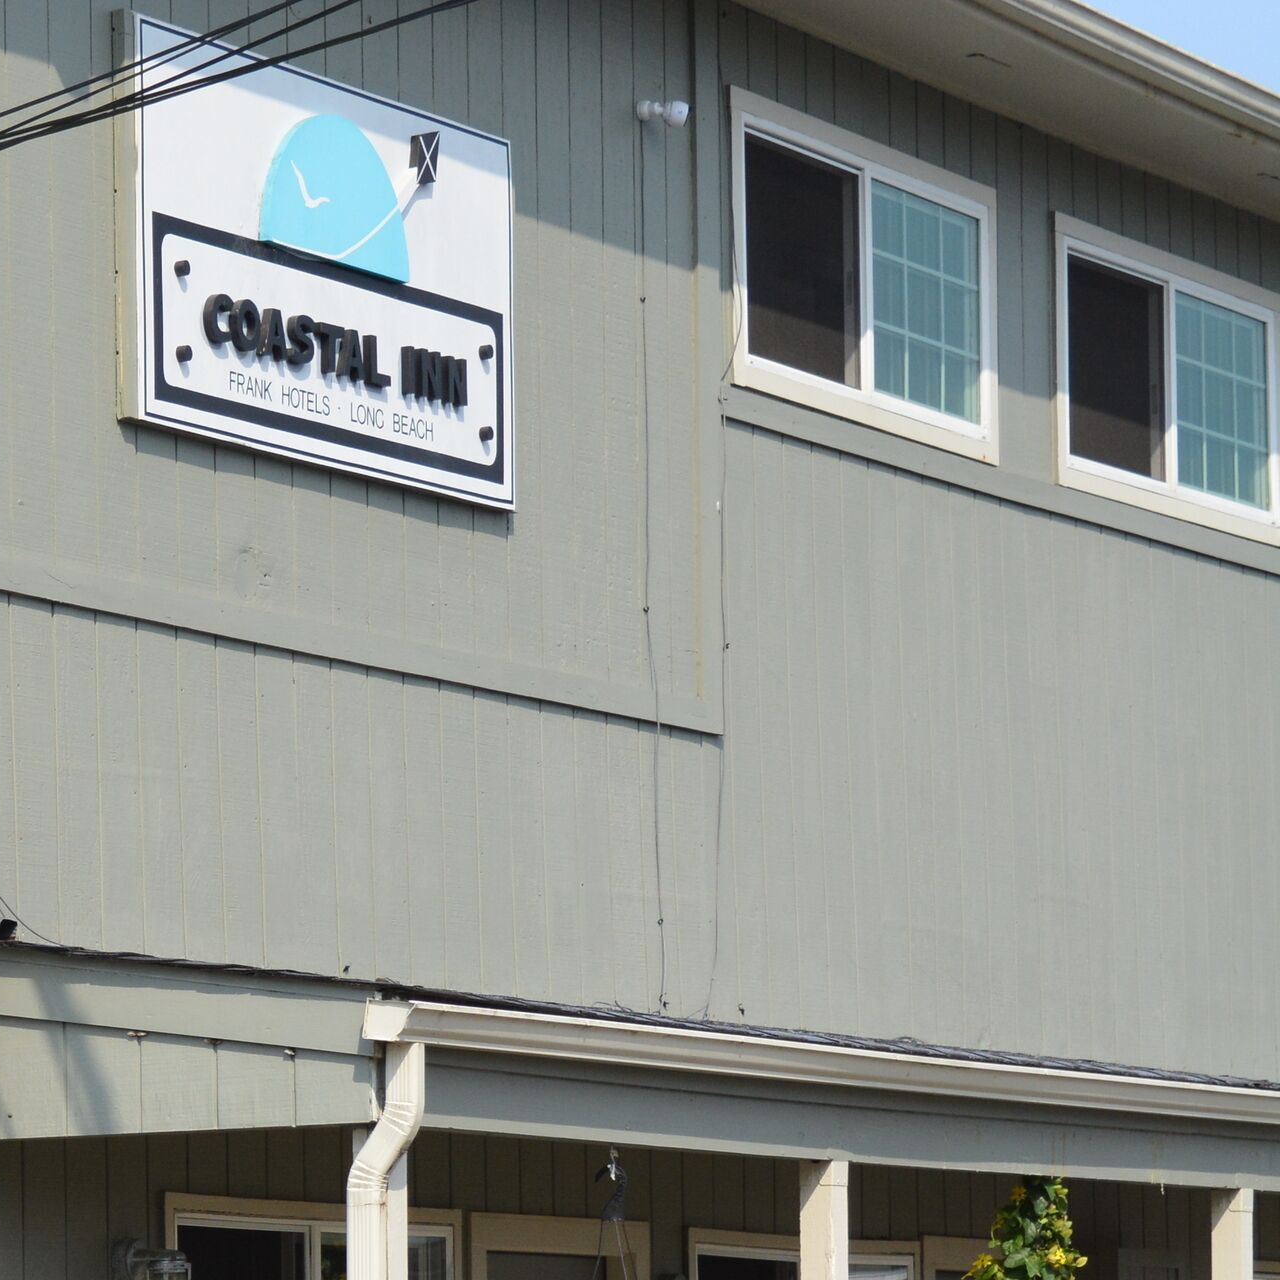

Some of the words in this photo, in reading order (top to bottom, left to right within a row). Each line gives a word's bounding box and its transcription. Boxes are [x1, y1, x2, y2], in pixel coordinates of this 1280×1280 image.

[203, 293, 391, 388] COASTAL
[401, 346, 468, 407] INN
[229, 370, 273, 402] FRANK
[281, 384, 331, 416] HOTELS
[350, 402, 384, 429] LONG
[393, 413, 434, 442] BEACH
